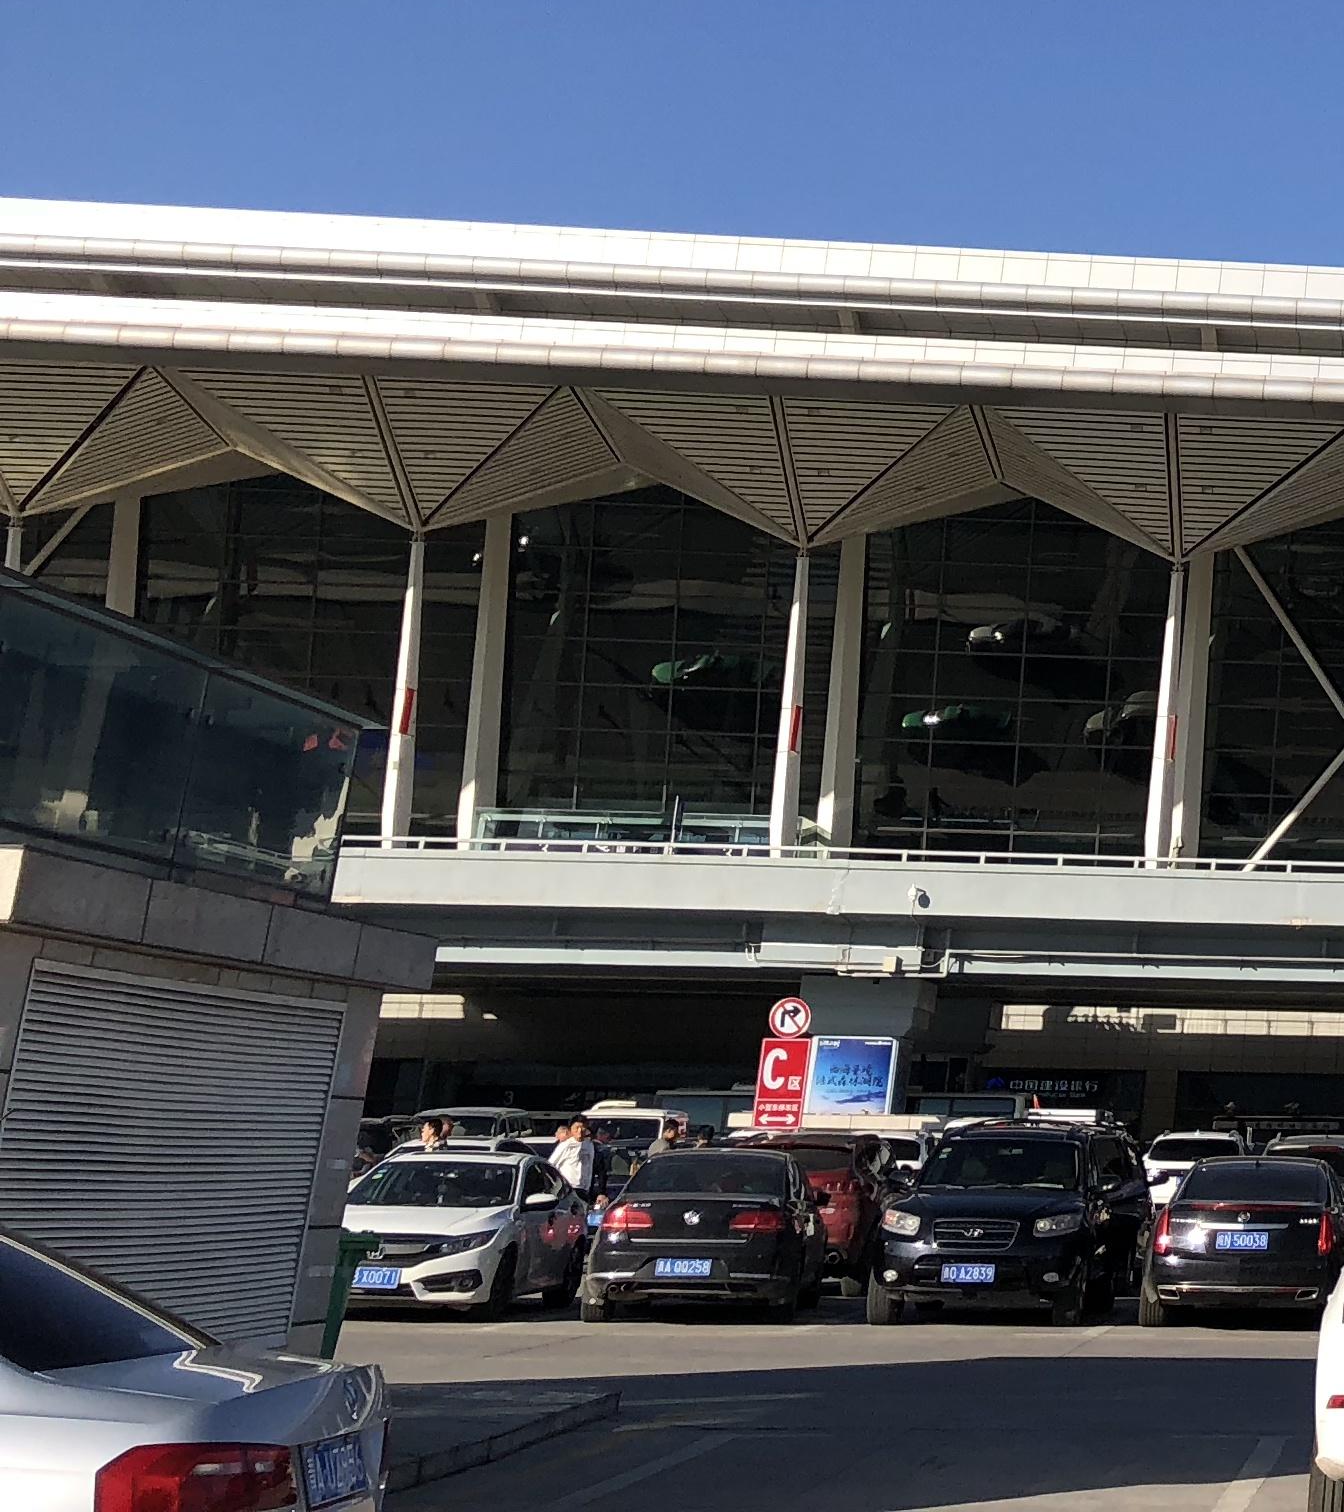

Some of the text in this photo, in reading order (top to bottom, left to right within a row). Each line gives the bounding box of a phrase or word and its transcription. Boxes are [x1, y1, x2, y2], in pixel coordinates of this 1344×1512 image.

[1009, 1079, 1098, 1092] 中国建设银行
